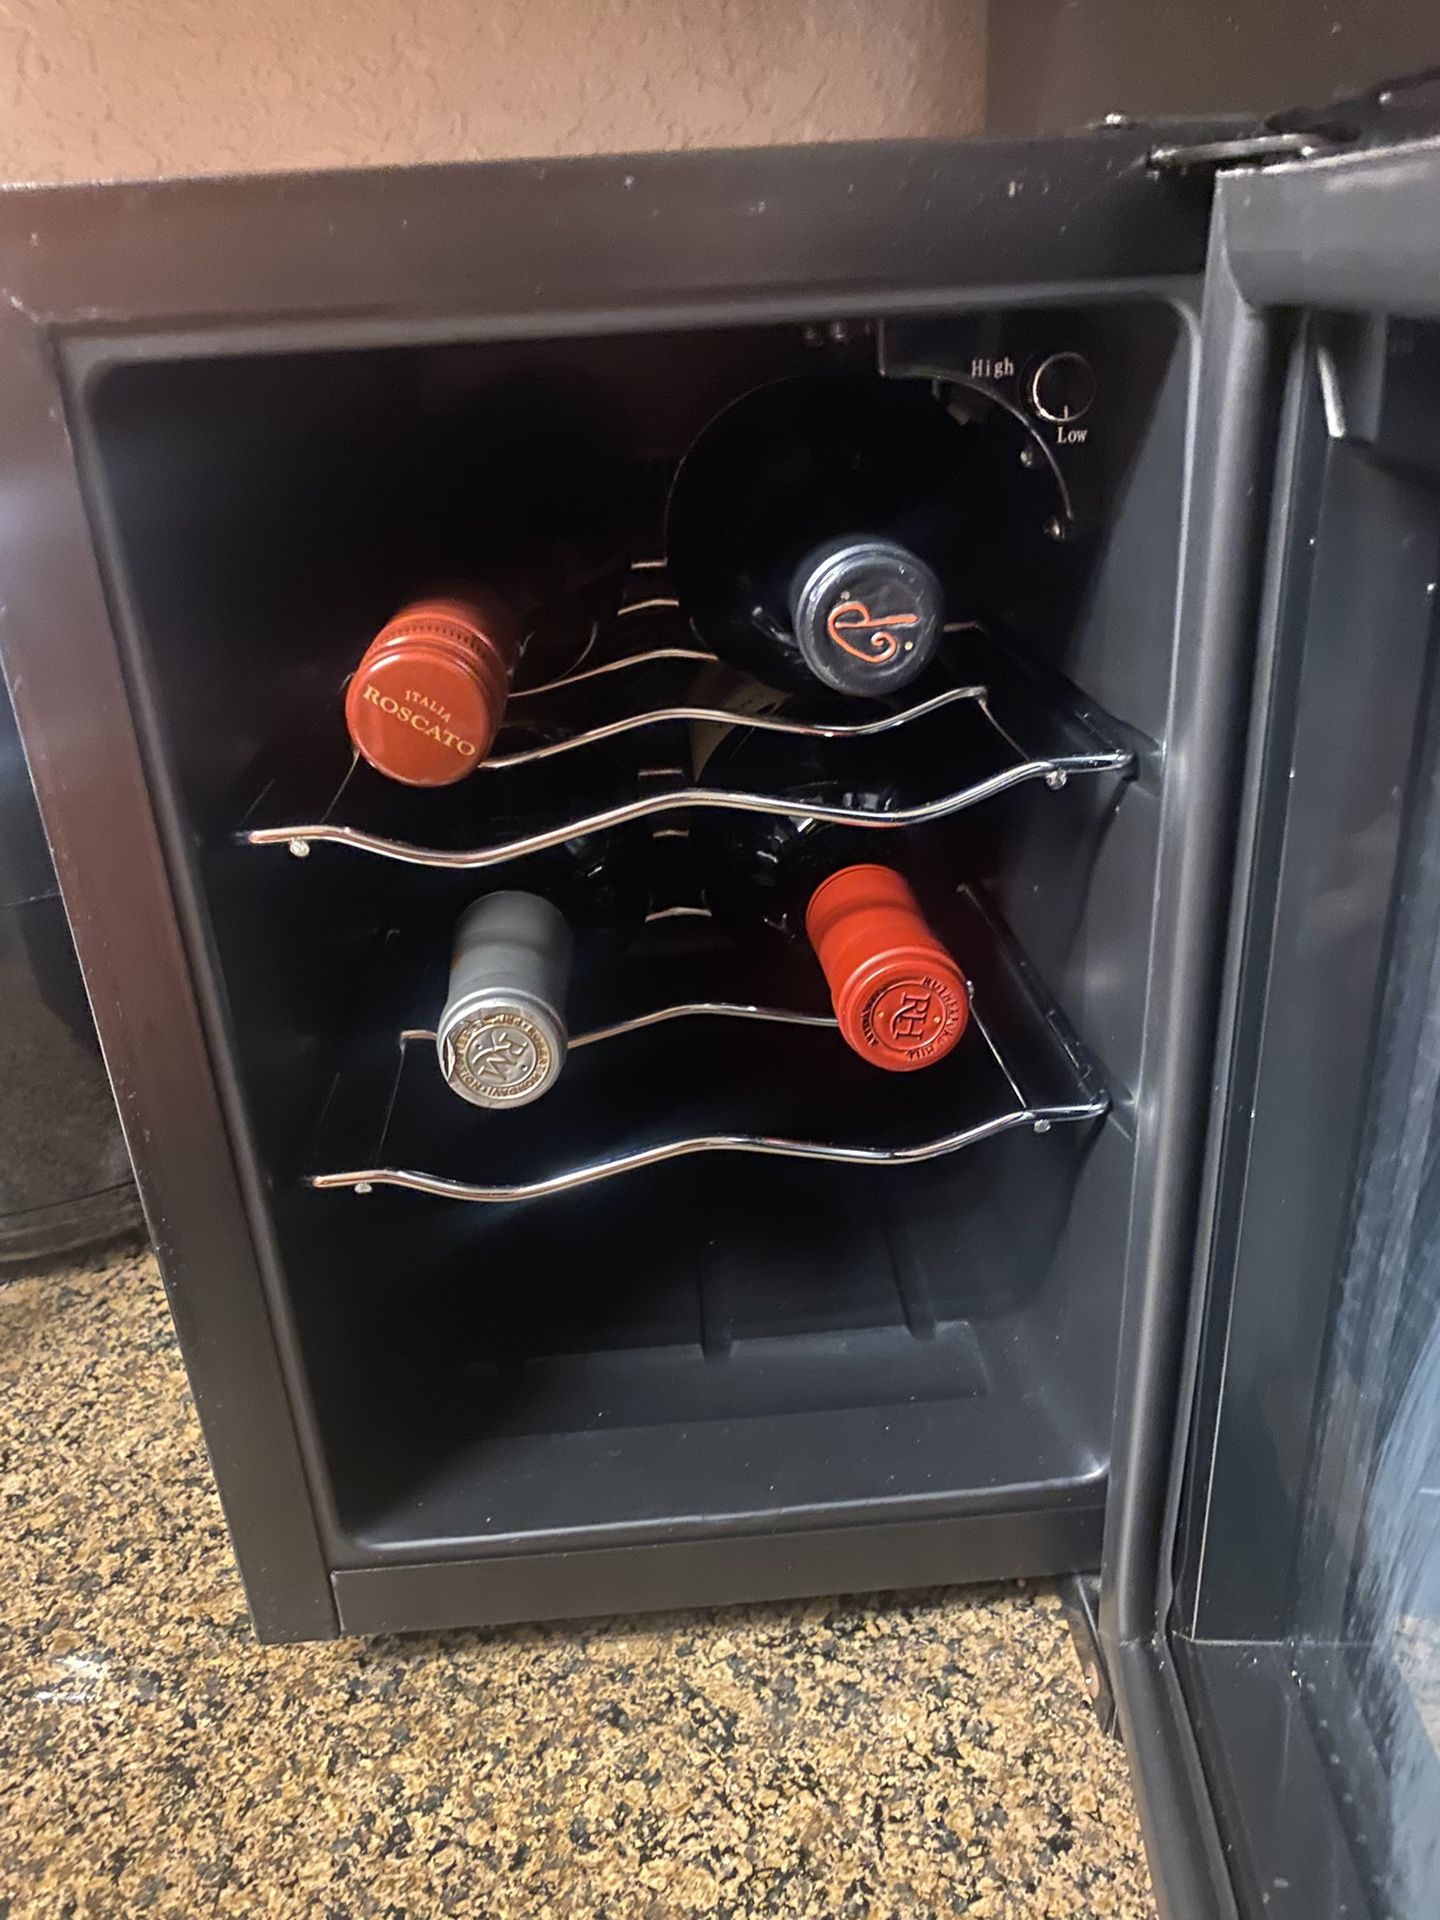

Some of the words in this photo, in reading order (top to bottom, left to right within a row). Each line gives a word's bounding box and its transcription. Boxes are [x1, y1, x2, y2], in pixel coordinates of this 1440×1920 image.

[971, 357, 1015, 379] High
[1057, 426, 1088, 444] Low
[363, 684, 476, 756] ROSCATO
[405, 690, 452, 723] ITALIA
